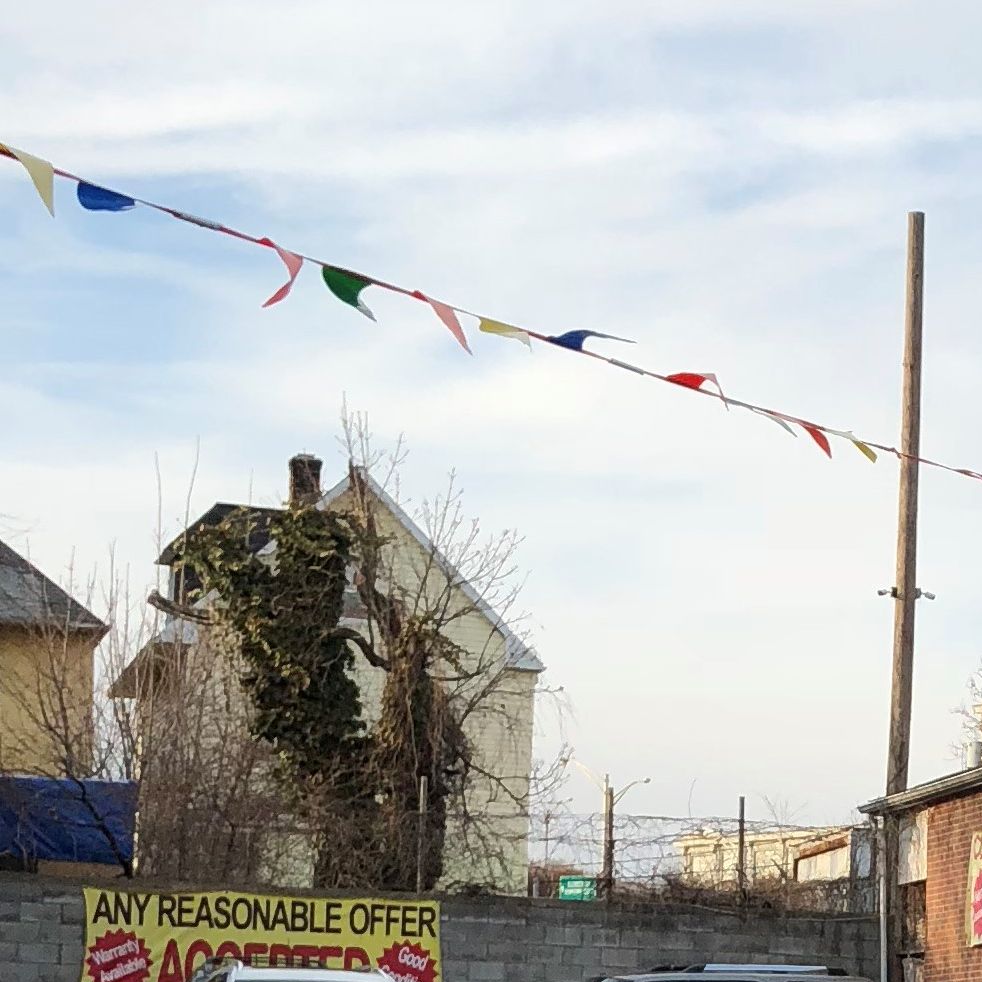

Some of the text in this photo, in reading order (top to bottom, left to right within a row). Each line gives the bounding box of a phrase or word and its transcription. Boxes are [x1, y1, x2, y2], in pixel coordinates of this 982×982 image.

[93, 891, 436, 937] ANY REASONABLE OFFER
[92, 939, 139, 965] Warranty
[398, 946, 428, 971] Good
